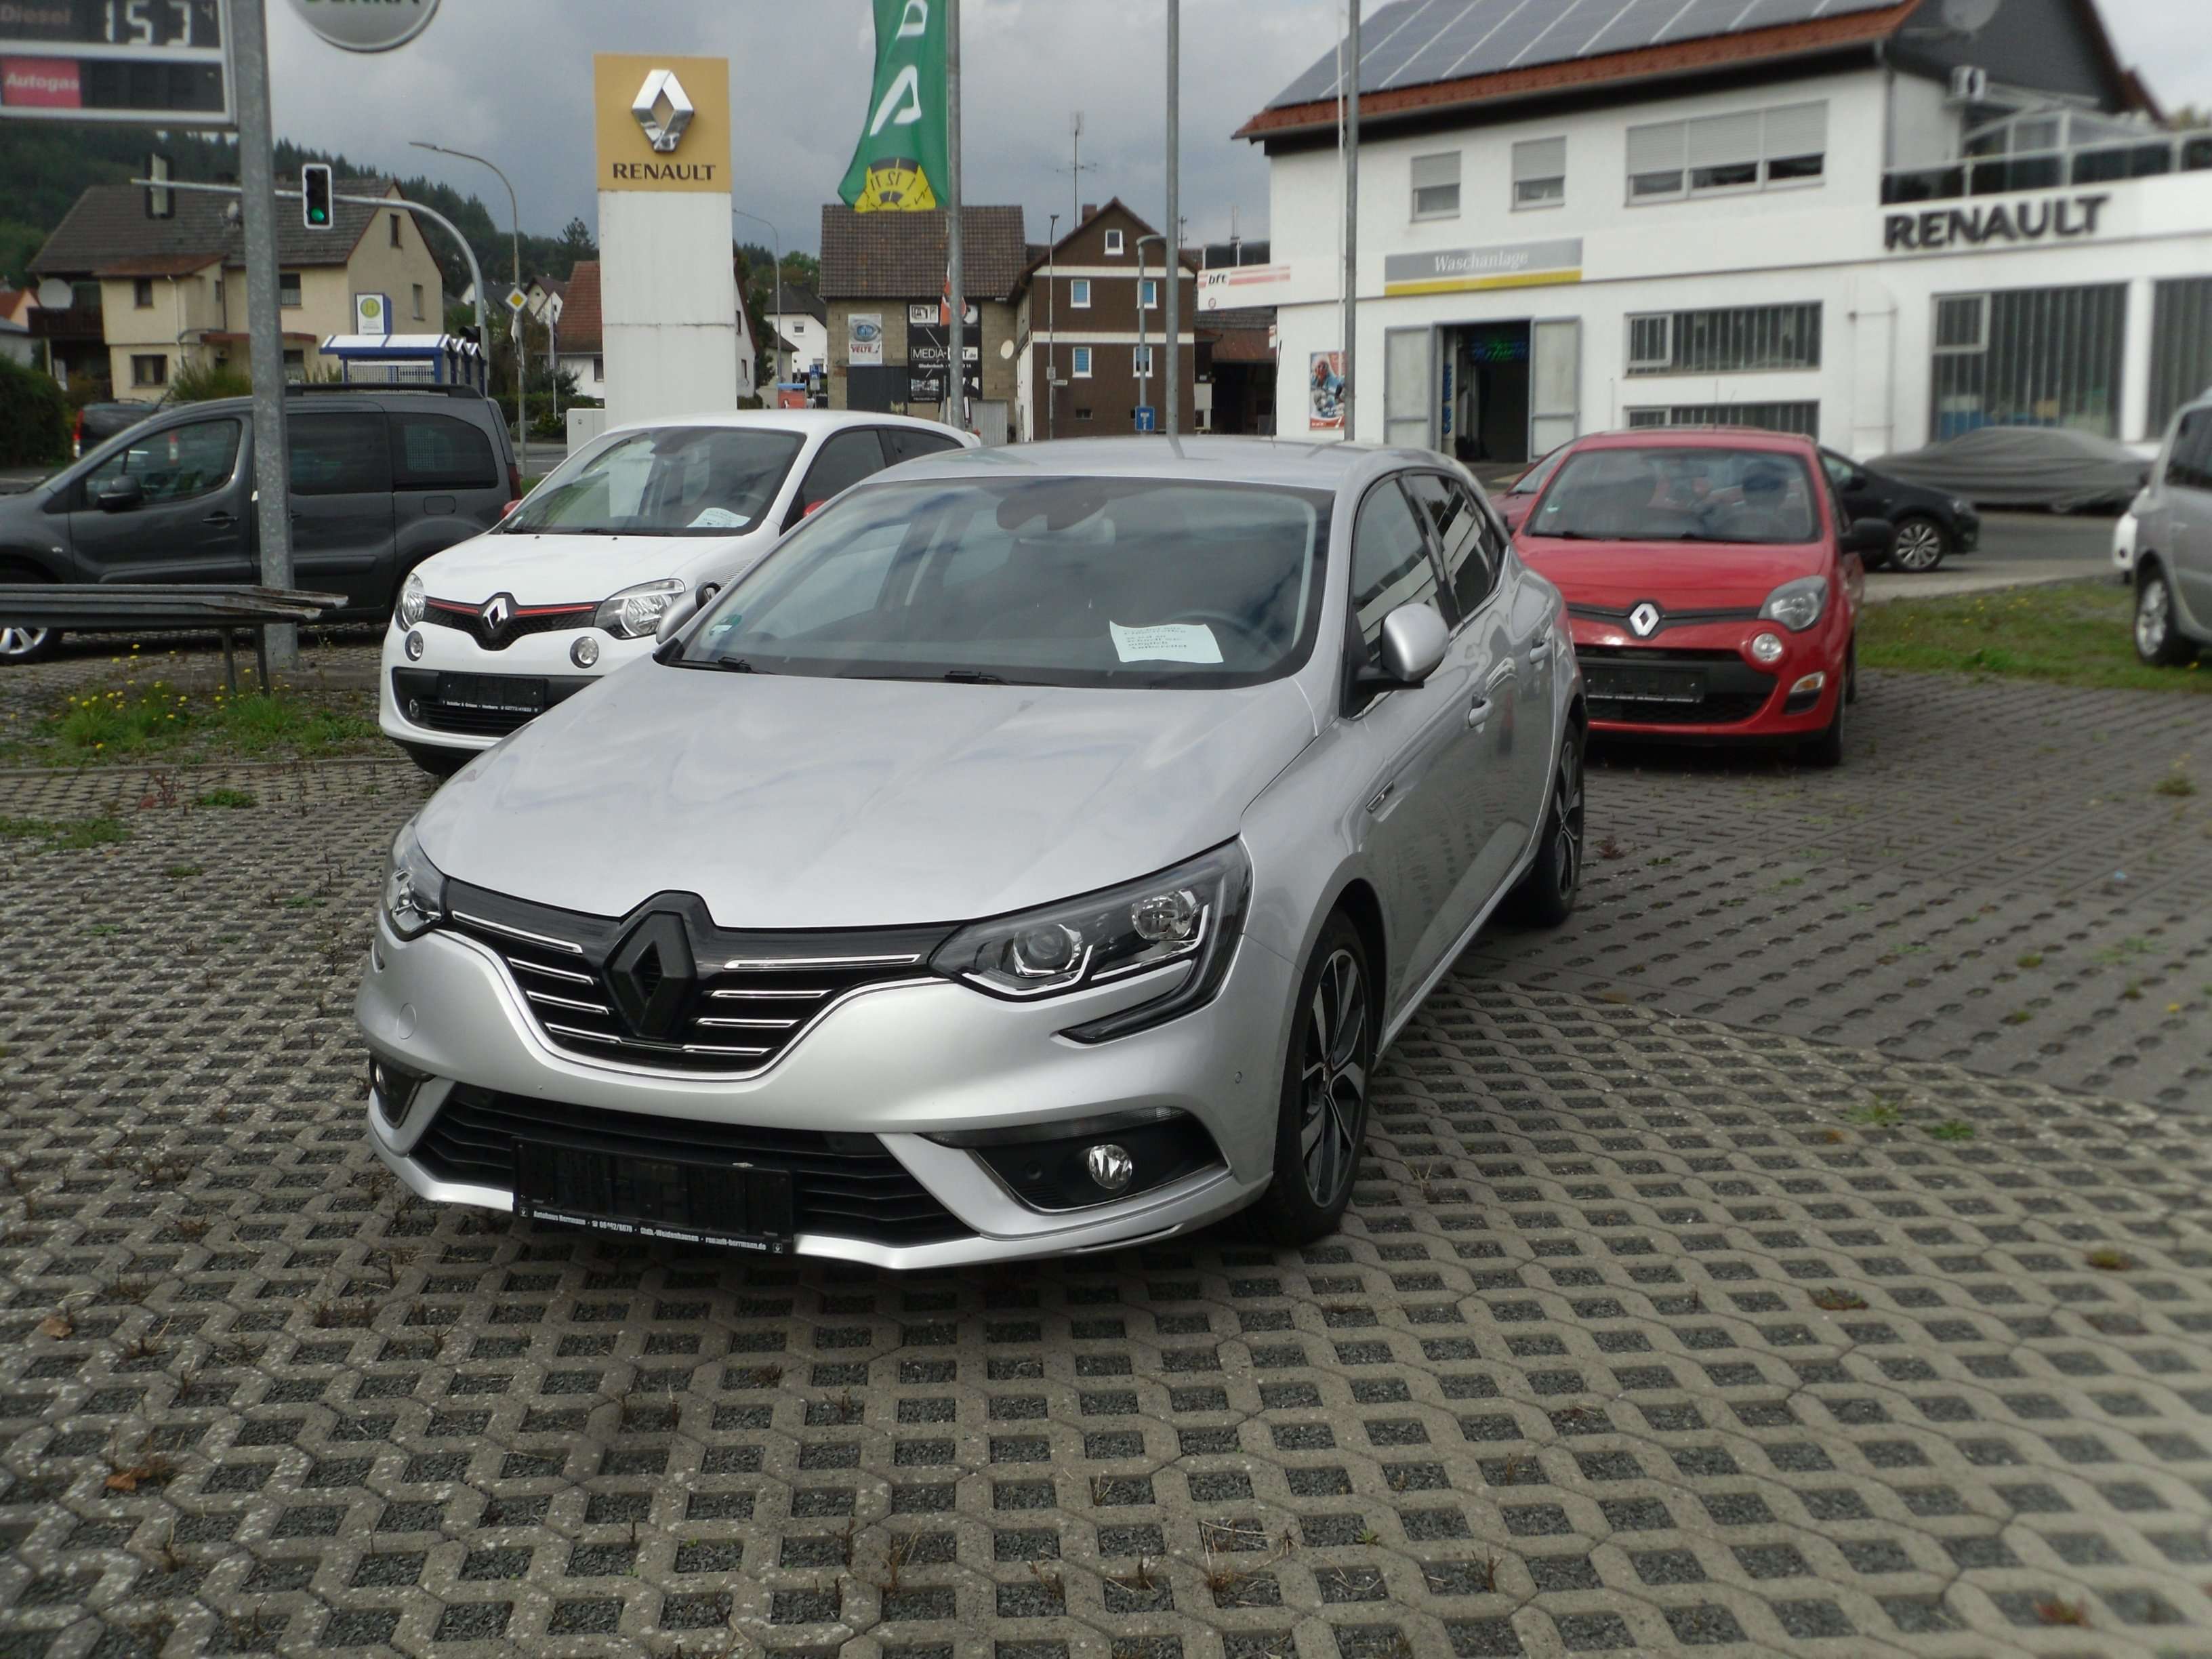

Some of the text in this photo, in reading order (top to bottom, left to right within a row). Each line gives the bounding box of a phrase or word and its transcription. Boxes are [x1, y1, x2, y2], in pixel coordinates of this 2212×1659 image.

[1, 3, 72, 23] Diesel
[6, 72, 80, 92] Autogas
[612, 162, 716, 181] RENAULT
[1884, 194, 2110, 251] RENAULT
[1434, 248, 1528, 272] Waschanlage
[1208, 273, 1226, 285] bft
